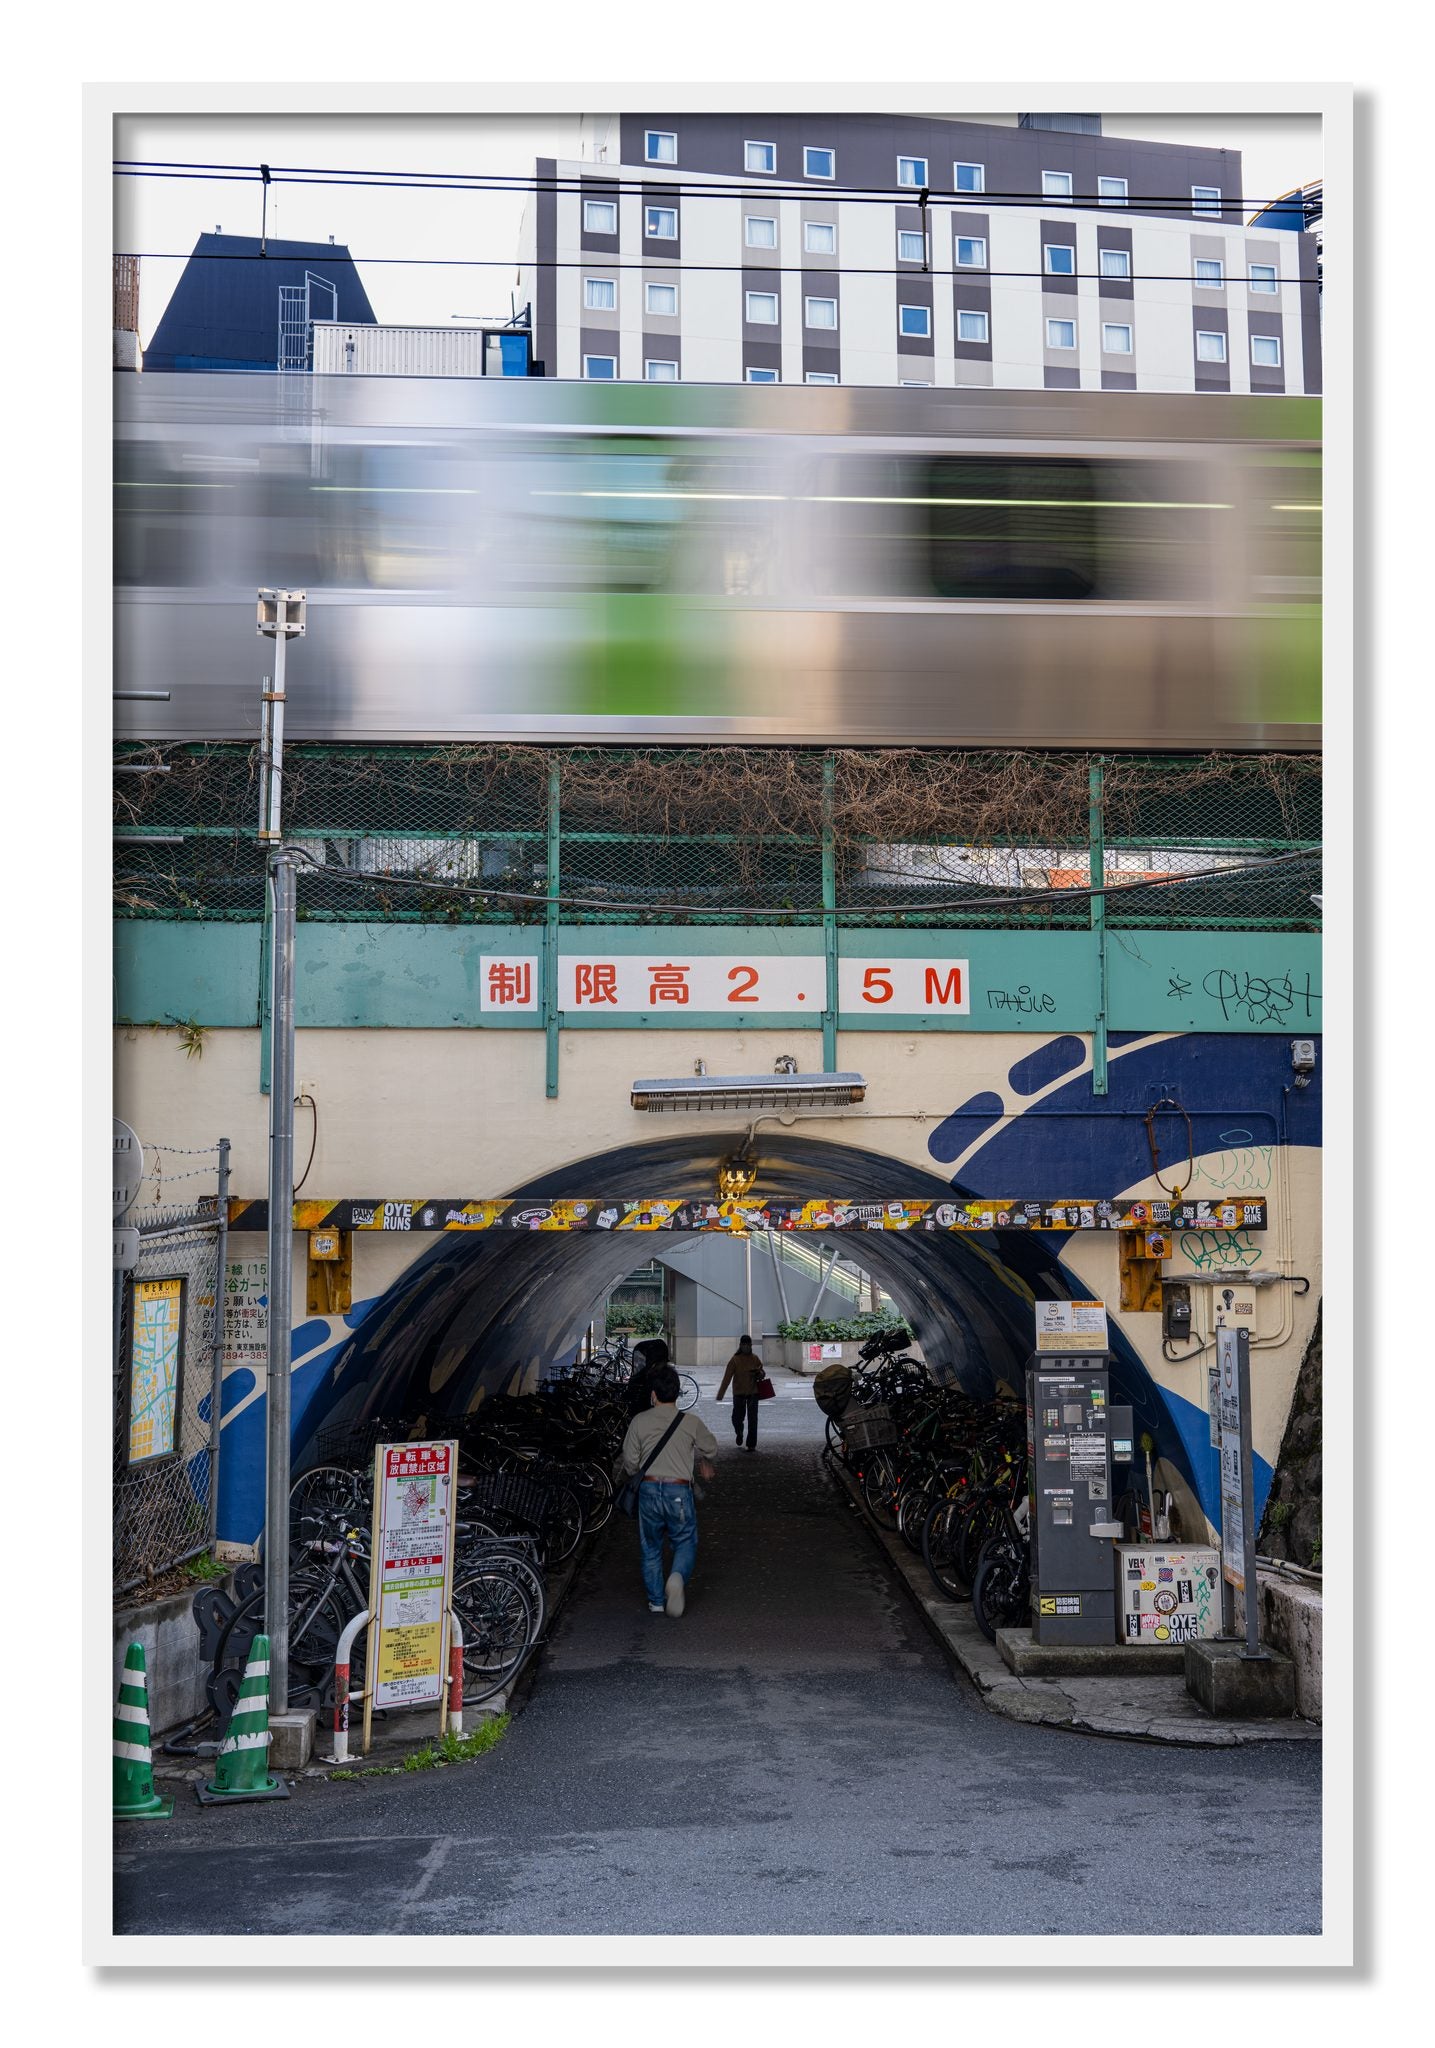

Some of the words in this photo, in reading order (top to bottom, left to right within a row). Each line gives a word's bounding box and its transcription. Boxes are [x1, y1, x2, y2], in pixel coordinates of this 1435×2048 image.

[384, 1202, 412, 1217] OYE
[1243, 1205, 1261, 1214] OYE
[383, 1217, 411, 1231] RUNS
[1244, 1213, 1261, 1223] RUNS
[389, 1461, 446, 1475] 放置禁止区域
[1169, 1614, 1197, 1629] OYE
[1170, 1628, 1197, 1644] RUNS
